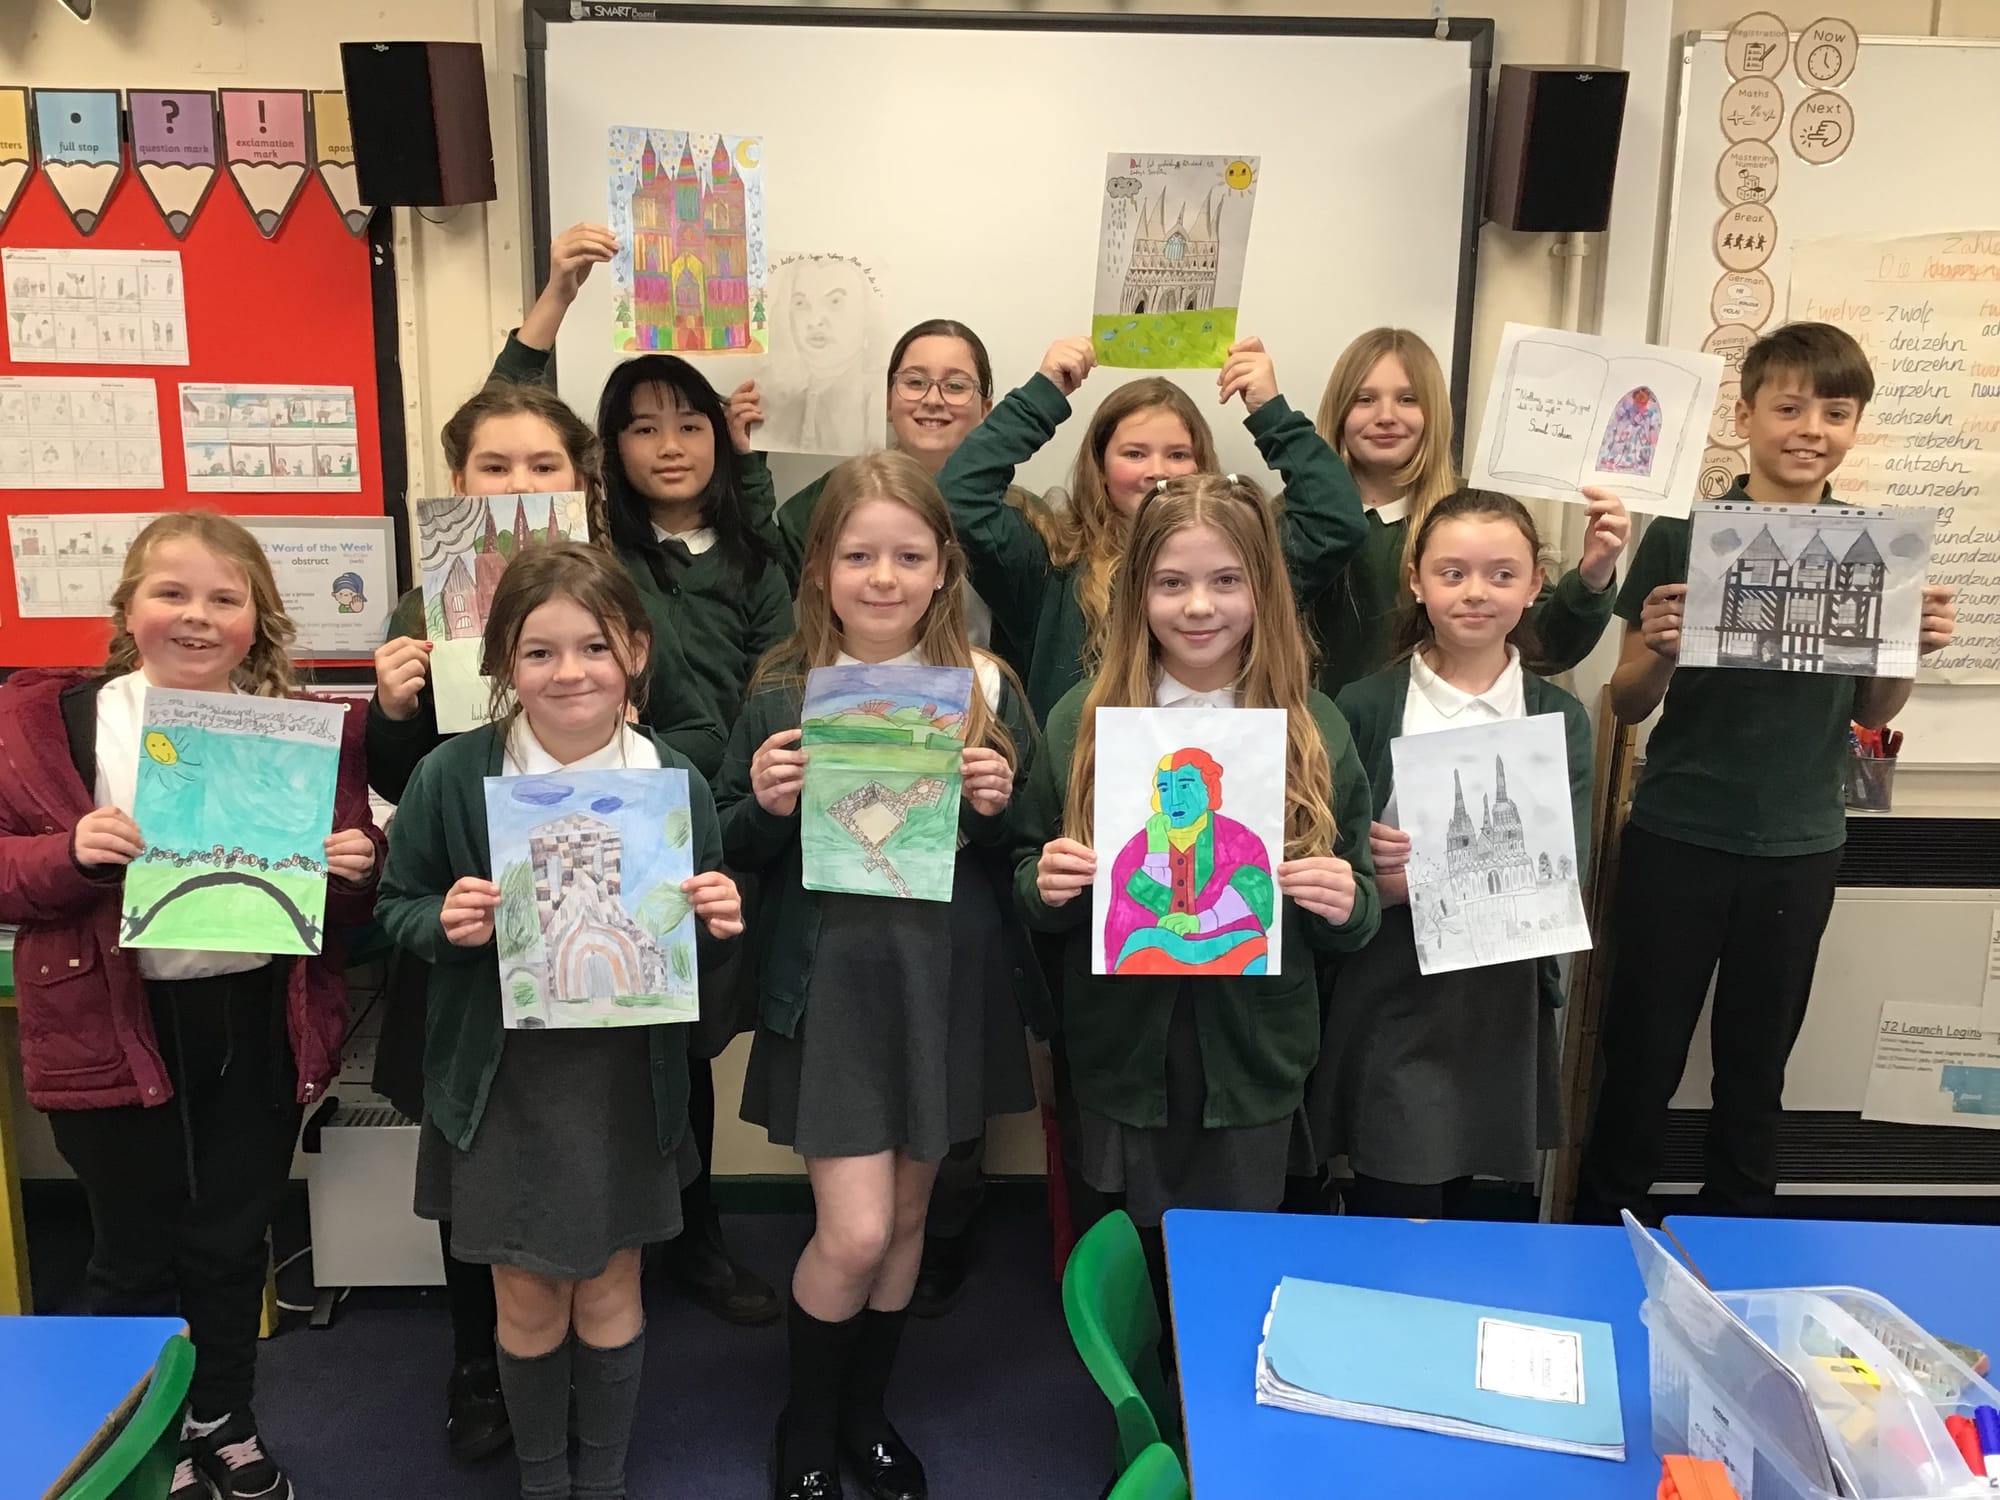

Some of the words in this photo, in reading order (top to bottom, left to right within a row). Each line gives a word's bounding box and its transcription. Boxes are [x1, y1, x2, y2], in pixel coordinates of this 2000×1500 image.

[594, 6, 632, 17] SMART
[1814, 29, 1846, 42] Now
[1738, 89, 1770, 98] Maths
[1806, 103, 1842, 114] Next
[0, 141, 23, 150] tters
[59, 141, 76, 153] full
[78, 143, 100, 155] stop
[236, 138, 295, 149] exclamation
[139, 144, 181, 155] question
[184, 144, 210, 153] mark
[253, 150, 279, 159] mark
[1735, 212, 1764, 223] Break
[1728, 274, 1764, 286] German
[1806, 298, 1873, 323] twelve
[1704, 456, 1733, 464] Lunch
[272, 544, 304, 553] Word
[307, 544, 317, 553] of
[320, 544, 338, 553] the
[340, 542, 374, 552] Week
[291, 557, 330, 566] obstruct
[1881, 1020, 1898, 1033] J2
[1901, 1022, 1943, 1036] Launch
[1946, 1026, 1982, 1040] Logins
